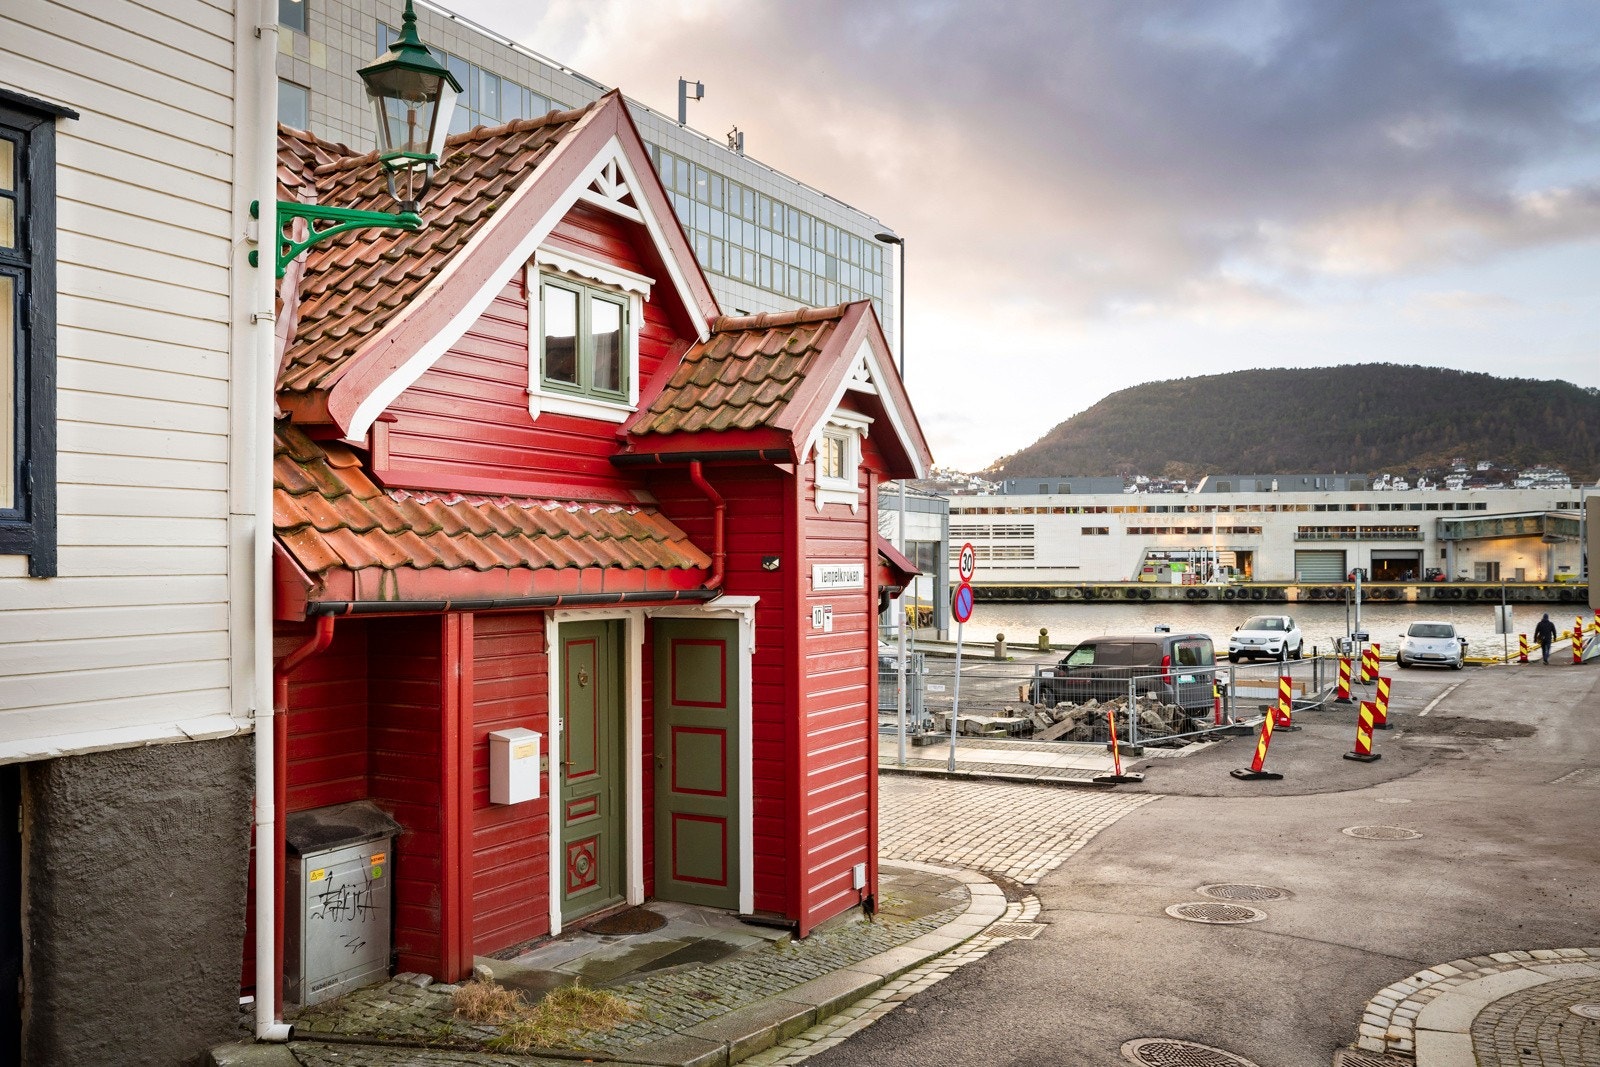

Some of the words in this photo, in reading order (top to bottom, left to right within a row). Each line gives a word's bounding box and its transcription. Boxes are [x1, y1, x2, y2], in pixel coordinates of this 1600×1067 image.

[962, 553, 972, 572] 30
[820, 567, 860, 586] Tempelkroken
[814, 609, 822, 625] 10
